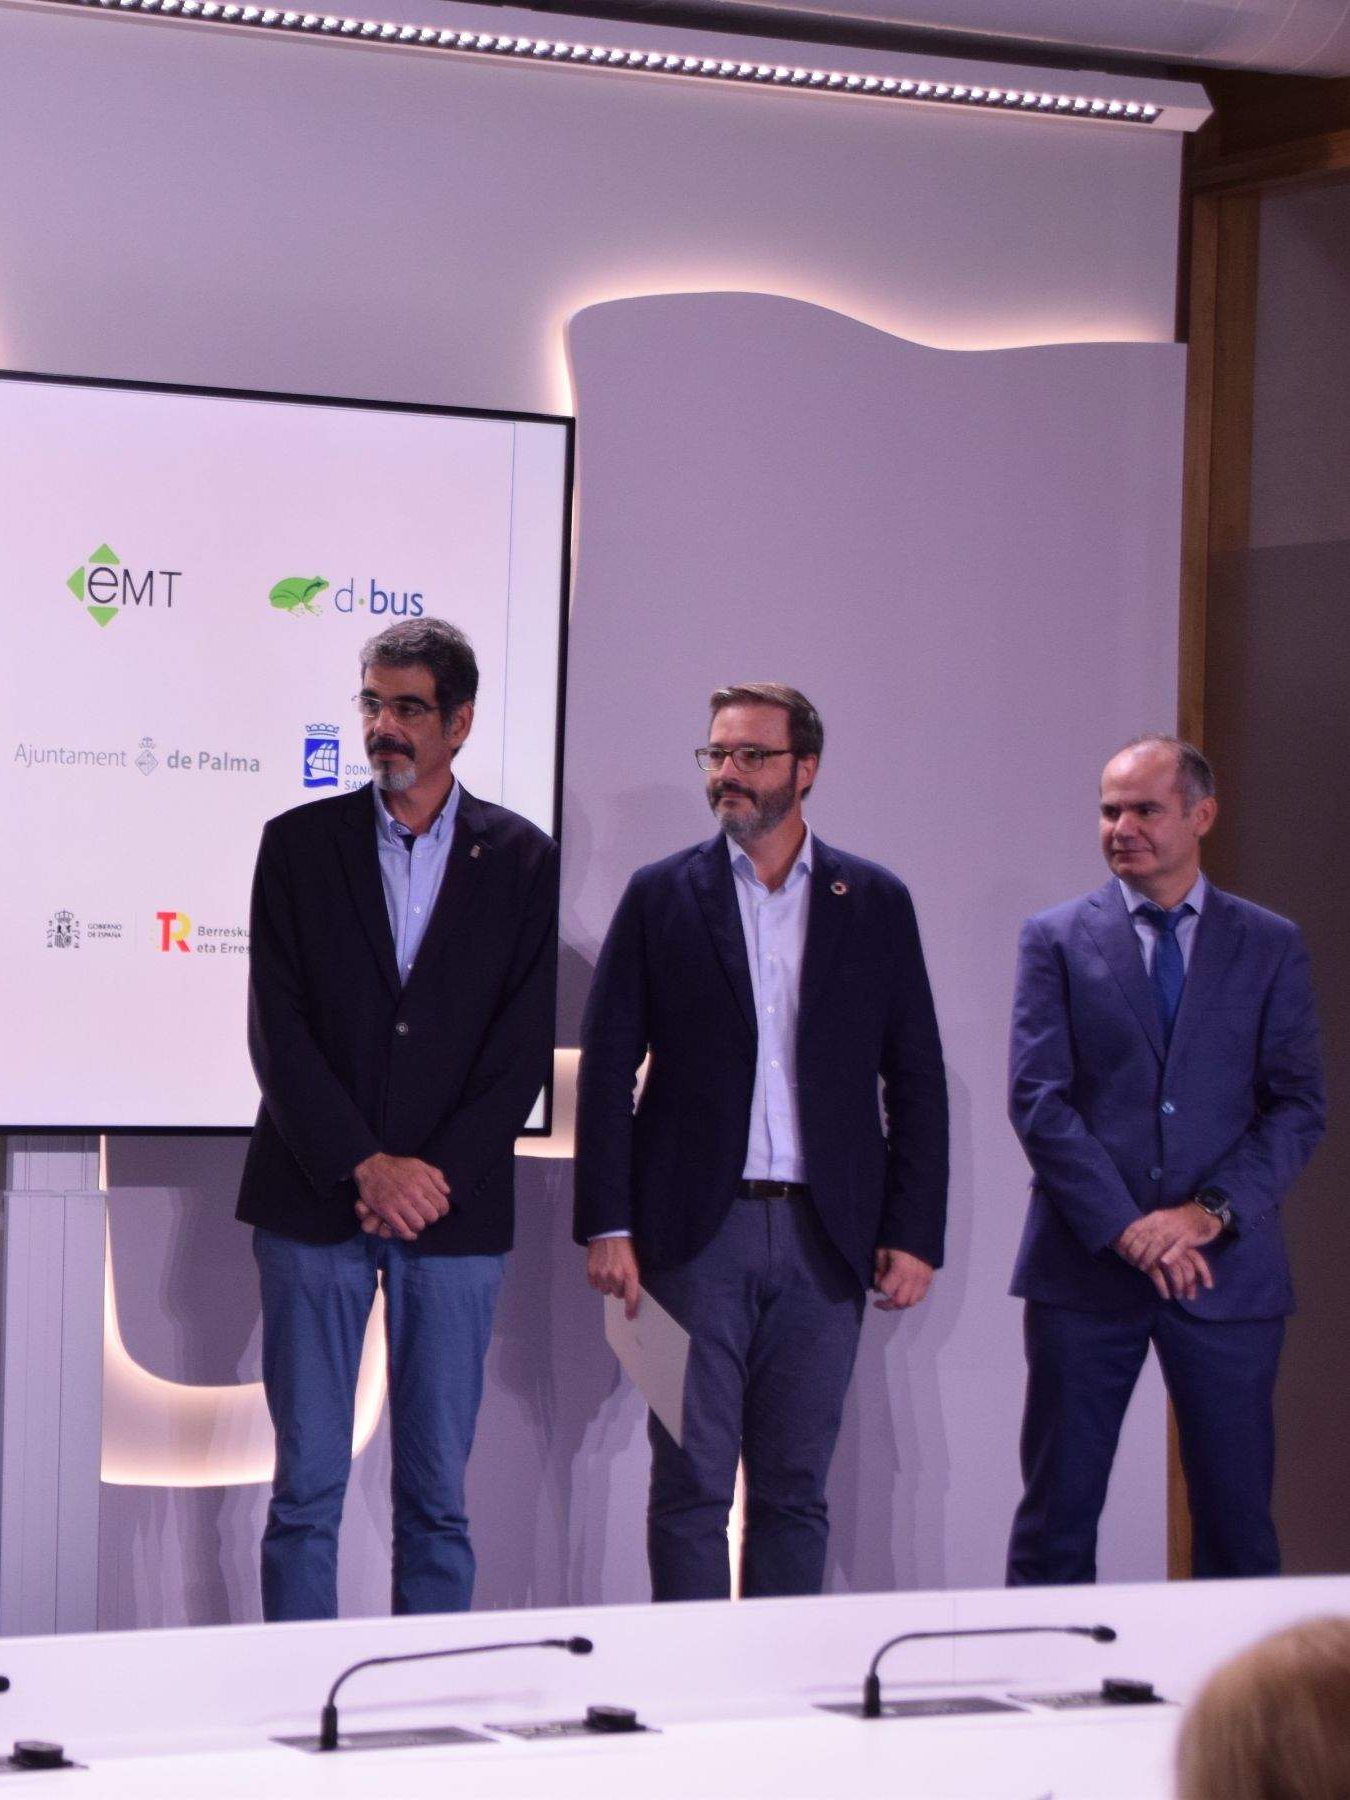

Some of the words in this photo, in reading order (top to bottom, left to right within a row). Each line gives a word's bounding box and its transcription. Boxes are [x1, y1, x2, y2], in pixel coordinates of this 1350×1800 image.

[14, 743, 127, 768] Ajuntament
[166, 750, 193, 770] de
[198, 751, 261, 773] Palma
[345, 765, 370, 776] DON
[197, 943, 216, 954] eta
